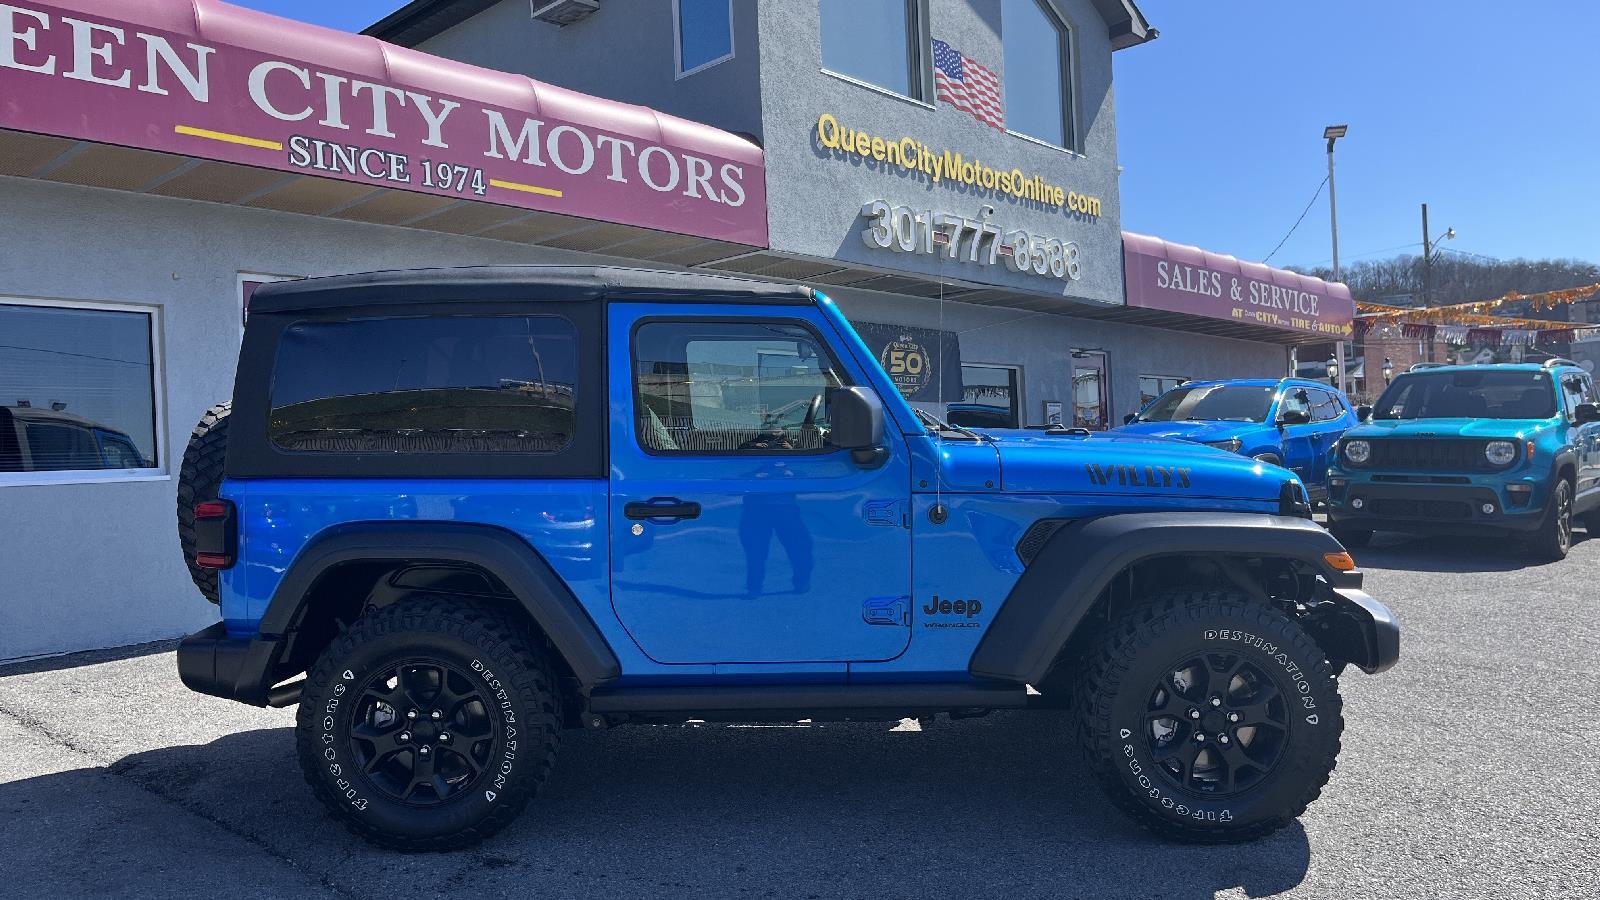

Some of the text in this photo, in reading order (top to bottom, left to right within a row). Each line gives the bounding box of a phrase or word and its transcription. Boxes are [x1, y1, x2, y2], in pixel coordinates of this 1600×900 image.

[248, 60, 461, 150] CITY
[482, 108, 746, 207] MOTORS
[288, 136, 488, 196] SINCE 1974
[861, 199, 1082, 281] 301-777-8588
[1157, 261, 1320, 316] SALES & SERVICE
[1231, 307, 1244, 318] AT
[1256, 311, 1278, 325] CITY
[1291, 318, 1311, 329] TIRE
[1311, 320, 1319, 332] &
[1319, 322, 1342, 334] AUTO
[890, 351, 922, 374] 50
[1084, 464, 1192, 488] WILLYS
[922, 595, 982, 619] Jeep
[1203, 629, 1316, 710] DESTINATION
[470, 659, 517, 789] DESTINATION
